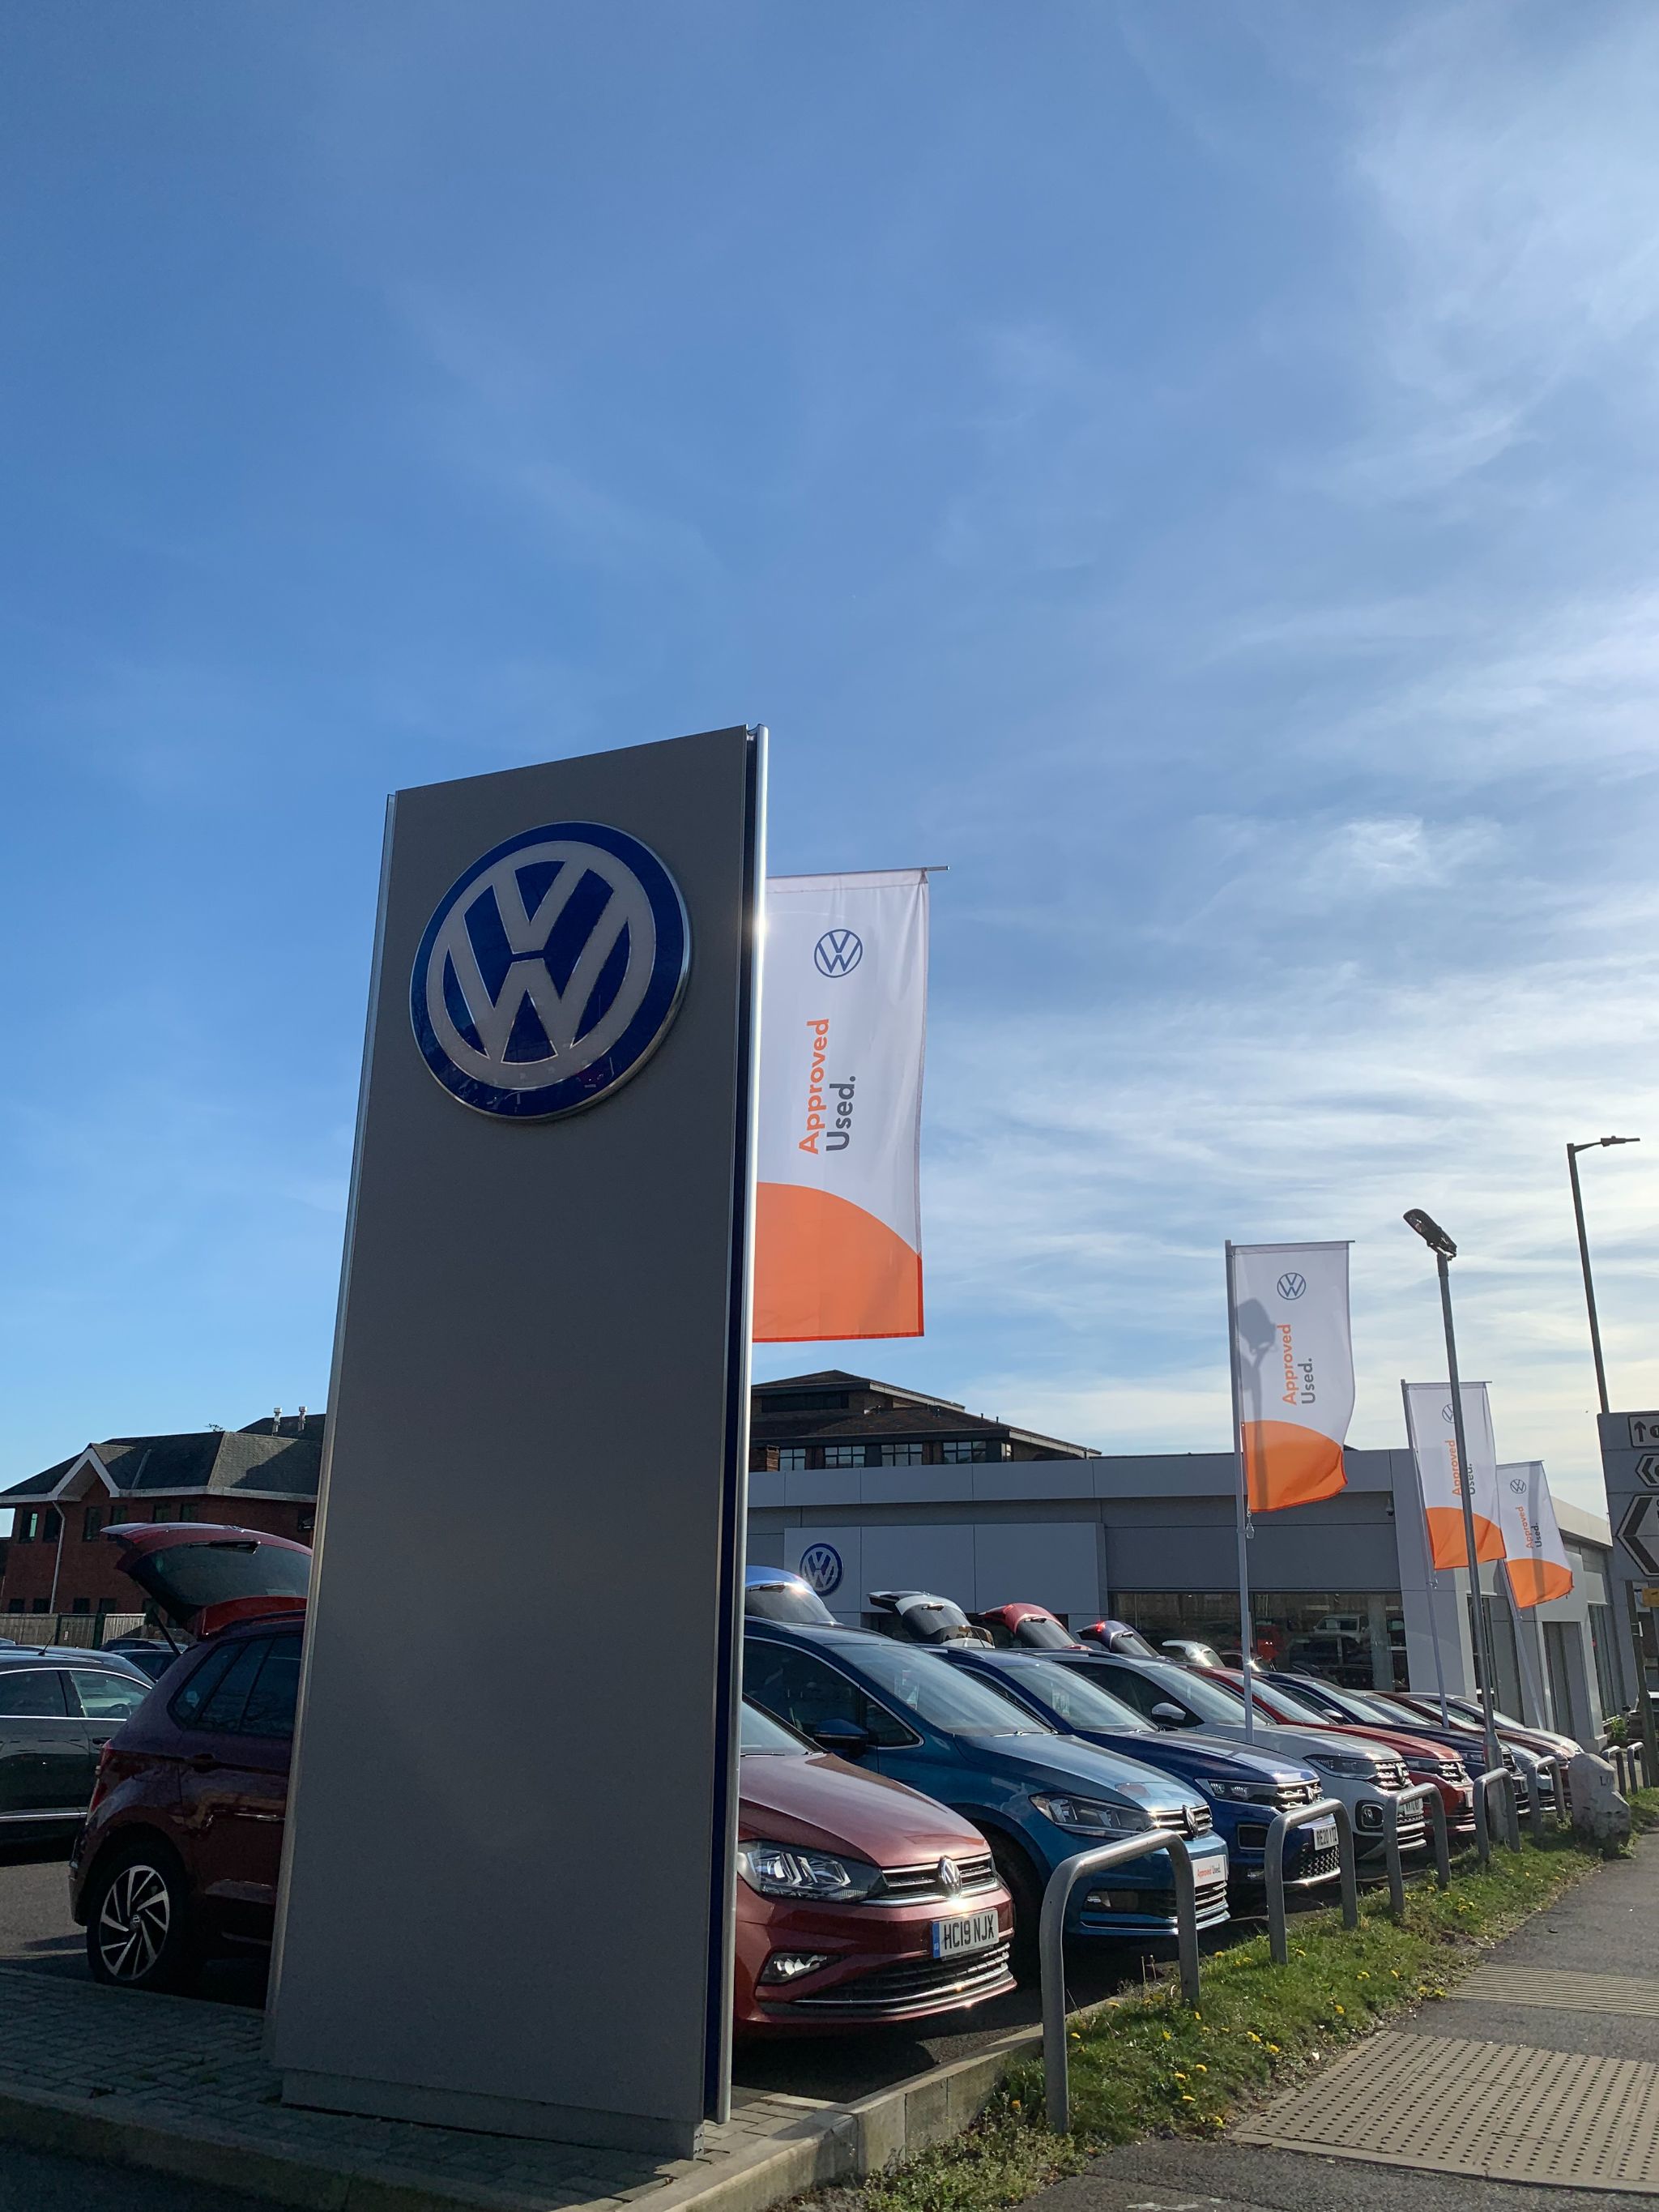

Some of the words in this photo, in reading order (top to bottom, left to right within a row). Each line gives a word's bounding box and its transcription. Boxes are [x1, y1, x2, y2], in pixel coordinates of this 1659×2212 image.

[799, 1018, 830, 1155] Approved
[825, 1075, 856, 1151] Used.
[1277, 1324, 1299, 1406] Approved
[1298, 1357, 1316, 1404] Used.
[1516, 1505, 1534, 1549] Approved
[1531, 1522, 1542, 1548] Used.
[943, 1919, 971, 1950] HC19
[973, 1914, 995, 1944] NJX
